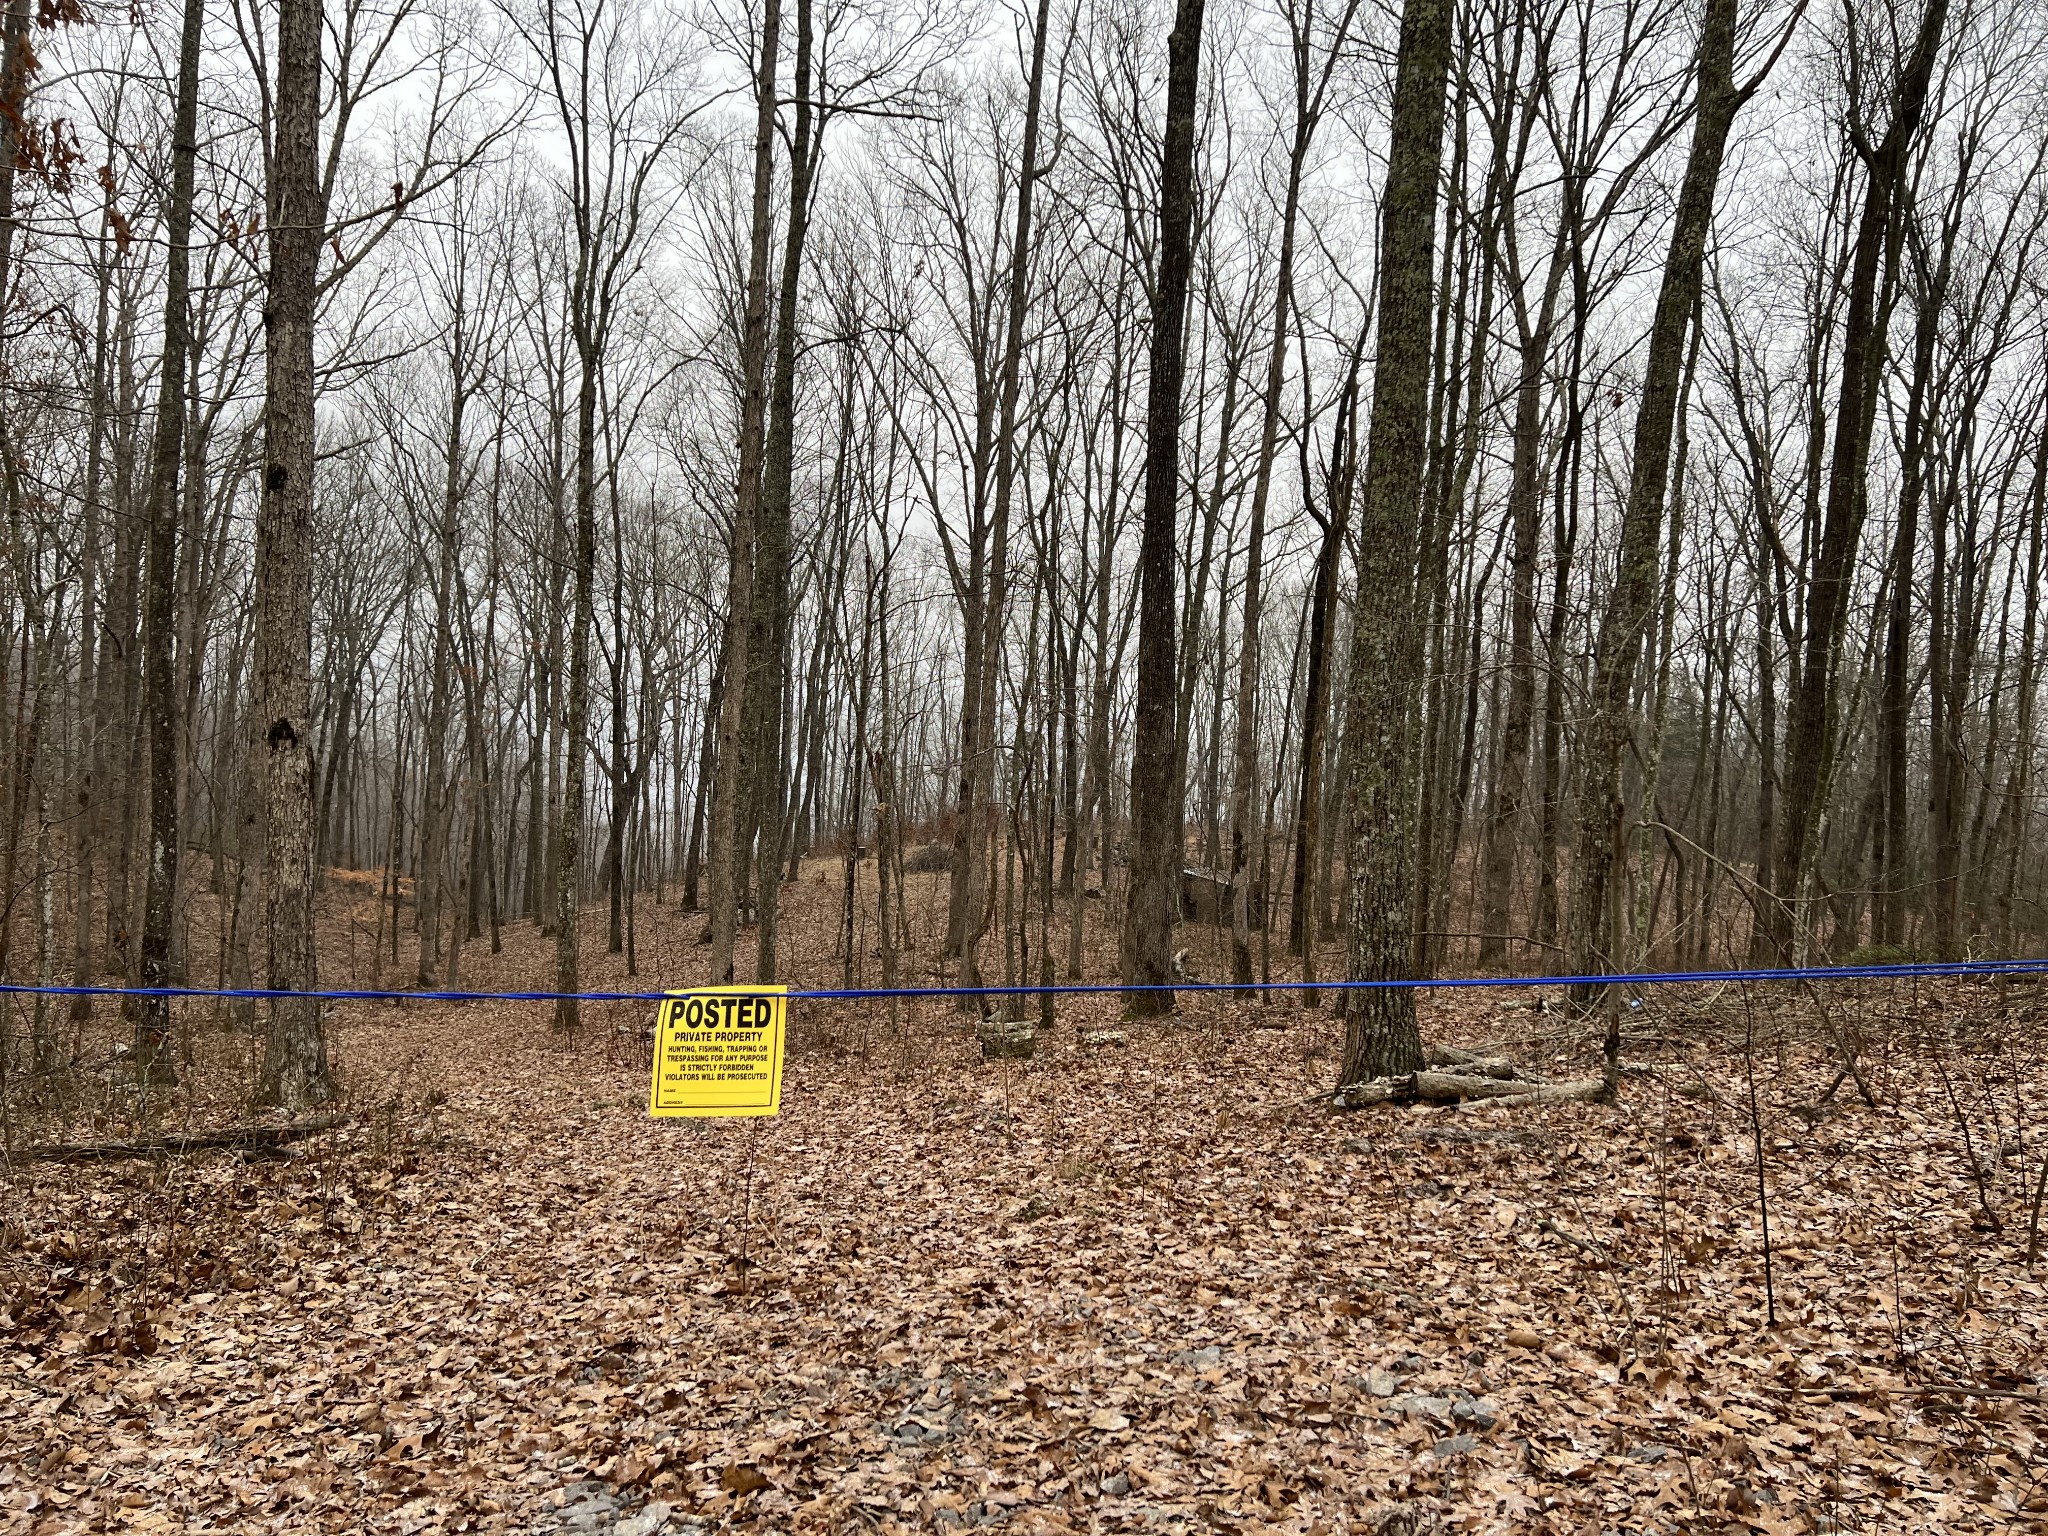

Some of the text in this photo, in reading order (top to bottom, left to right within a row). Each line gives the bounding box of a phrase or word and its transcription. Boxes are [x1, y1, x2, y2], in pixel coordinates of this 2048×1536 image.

[669, 999, 772, 1029] POSTED
[675, 1032, 763, 1042] PRIVATE PROPERTY
[668, 1046, 697, 1054] HUNTING,
